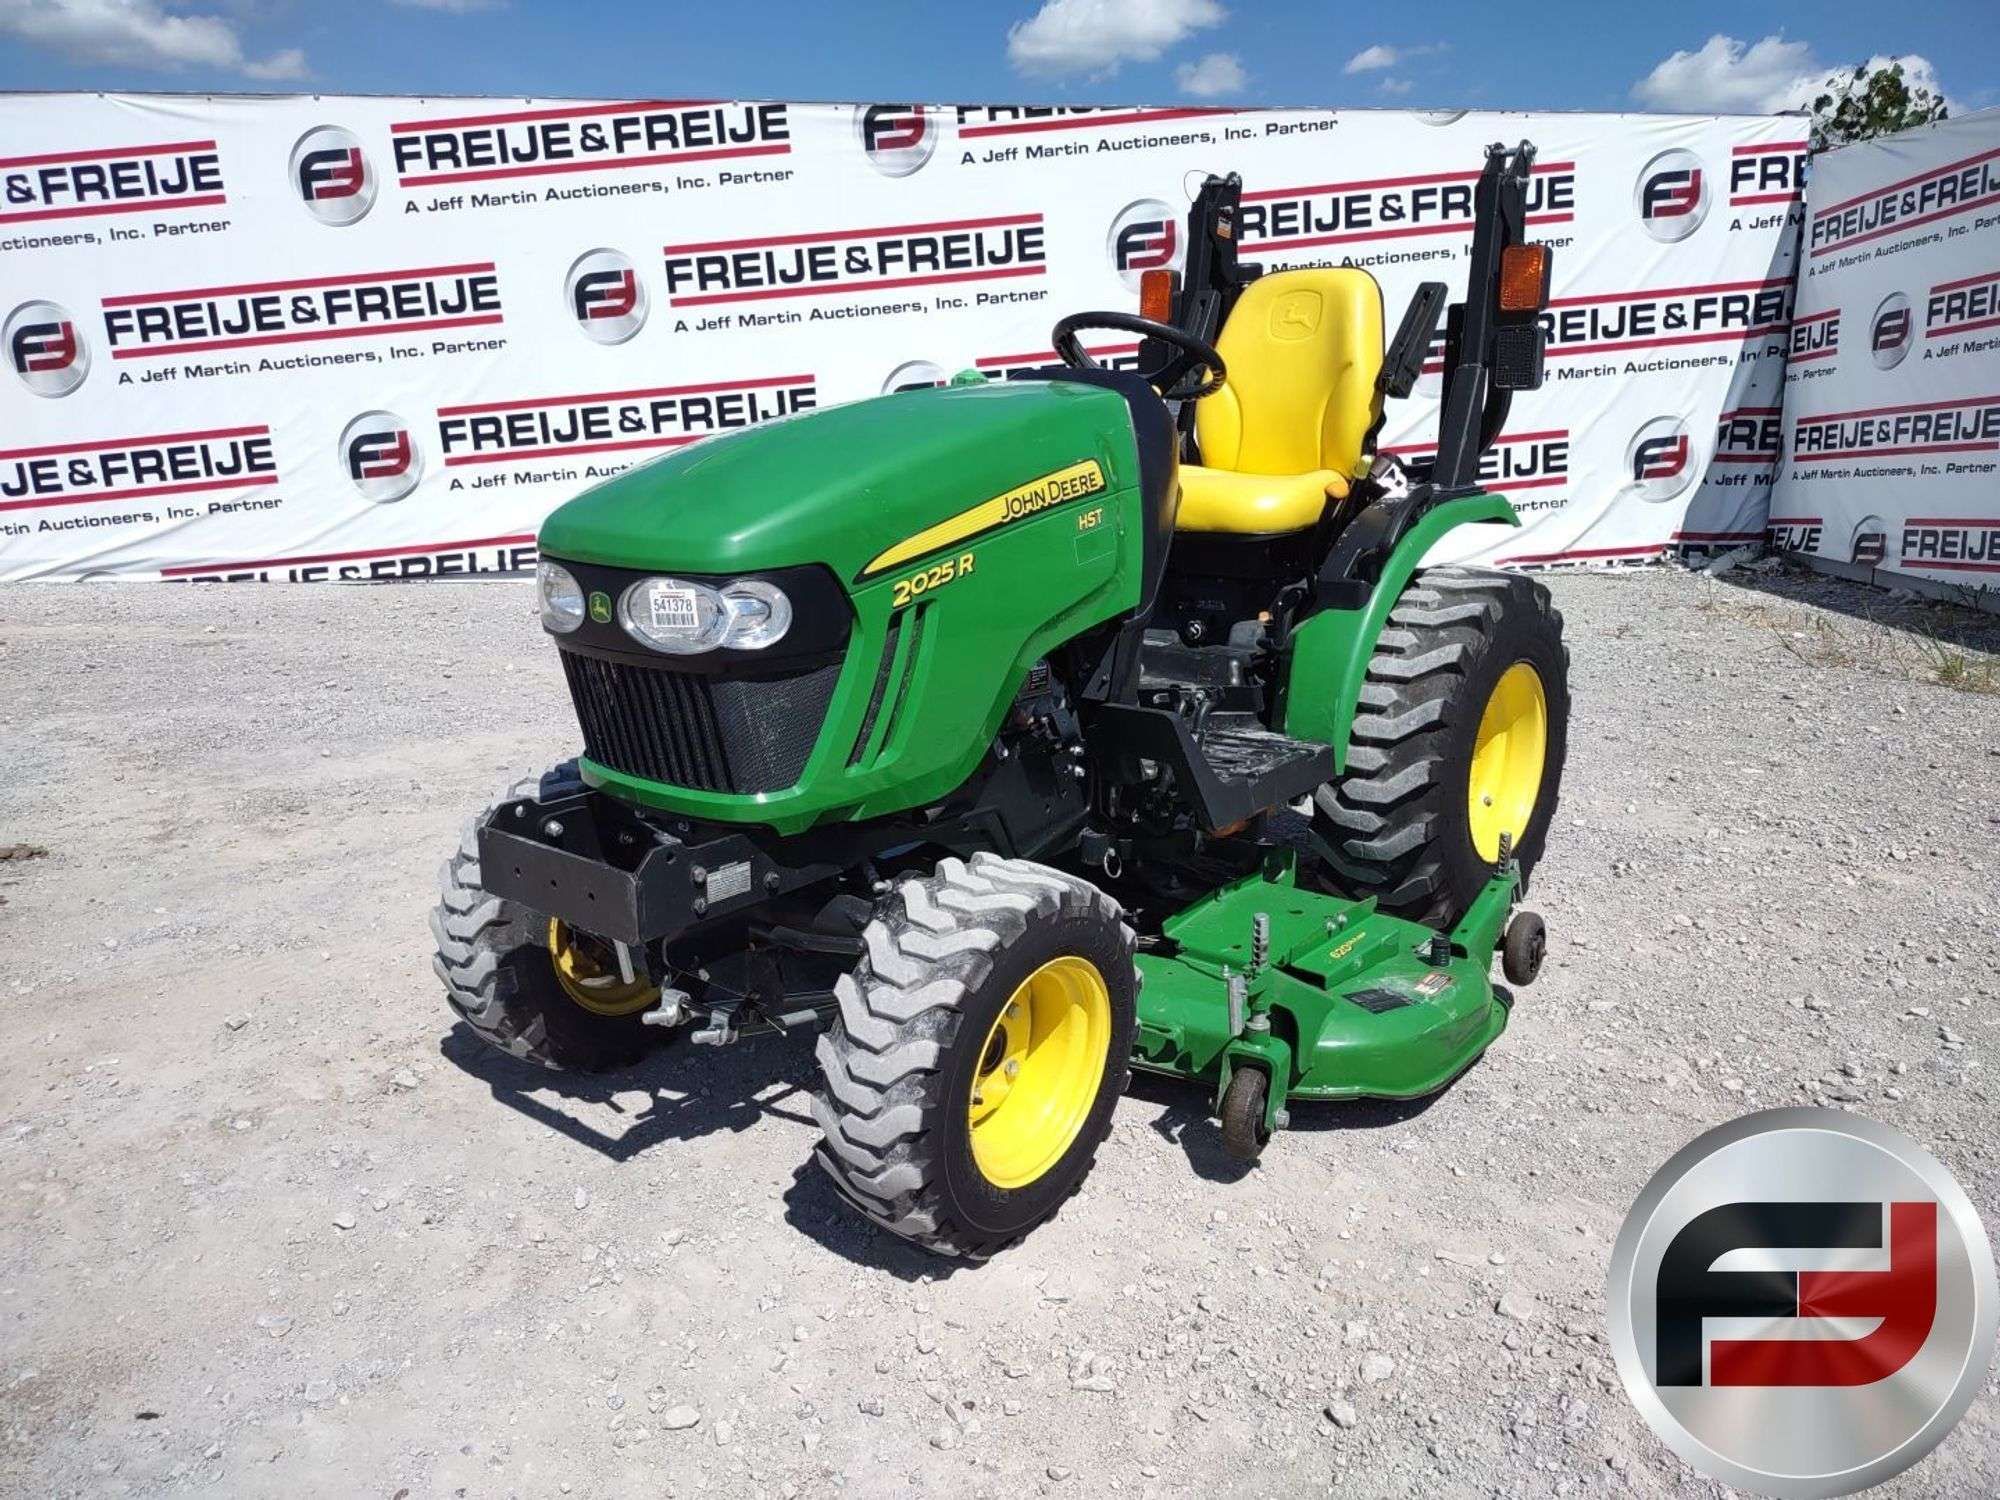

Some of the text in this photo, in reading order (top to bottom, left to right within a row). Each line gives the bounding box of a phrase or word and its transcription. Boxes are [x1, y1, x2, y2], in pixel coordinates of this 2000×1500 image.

[960, 119, 1339, 165] A Jeff Martin Auctioneers, Inc. Partner
[404, 170, 794, 214] A Jeff Martin Auctioneers, Inc. Partner
[1238, 195, 1372, 240] REIJE
[1411, 175, 1575, 222] FRJE
[1, 220, 231, 251] ctioneers, Inc. Partner
[1729, 218, 1742, 232] A
[1748, 214, 1784, 230] Jeff
[1340, 247, 1457, 268] Auctioneers,
[674, 290, 1048, 333] A Jeff Martin Auctioneers, Inc. Partner
[1926, 284, 2000, 327] FREI
[1538, 302, 1657, 345] REIJE
[1793, 319, 1840, 353] EIJE
[118, 339, 507, 385] A Jeff Martin Auctioneers, Inc. Partner
[1557, 364, 1617, 381] Martin
[1623, 355, 1734, 374] Auctioneers,
[1476, 442, 1569, 481] EIJE
[1920, 463, 1941, 475] Inc.
[1945, 462, 1997, 474] Partner
[449, 478, 465, 491] A
[471, 473, 507, 489] Jeff
[513, 468, 578, 485] Martin
[1000, 471, 1098, 518] JOHN DEERE
[1714, 474, 1748, 487] Jeff
[38, 512, 160, 533] Auctioneers,
[166, 506, 200, 520] Inc.
[207, 498, 283, 515] Partner
[1078, 509, 1102, 530] HST
[1513, 499, 1569, 513] artner
[1901, 528, 2000, 561] FREIJE
[654, 599, 692, 611] 541378
